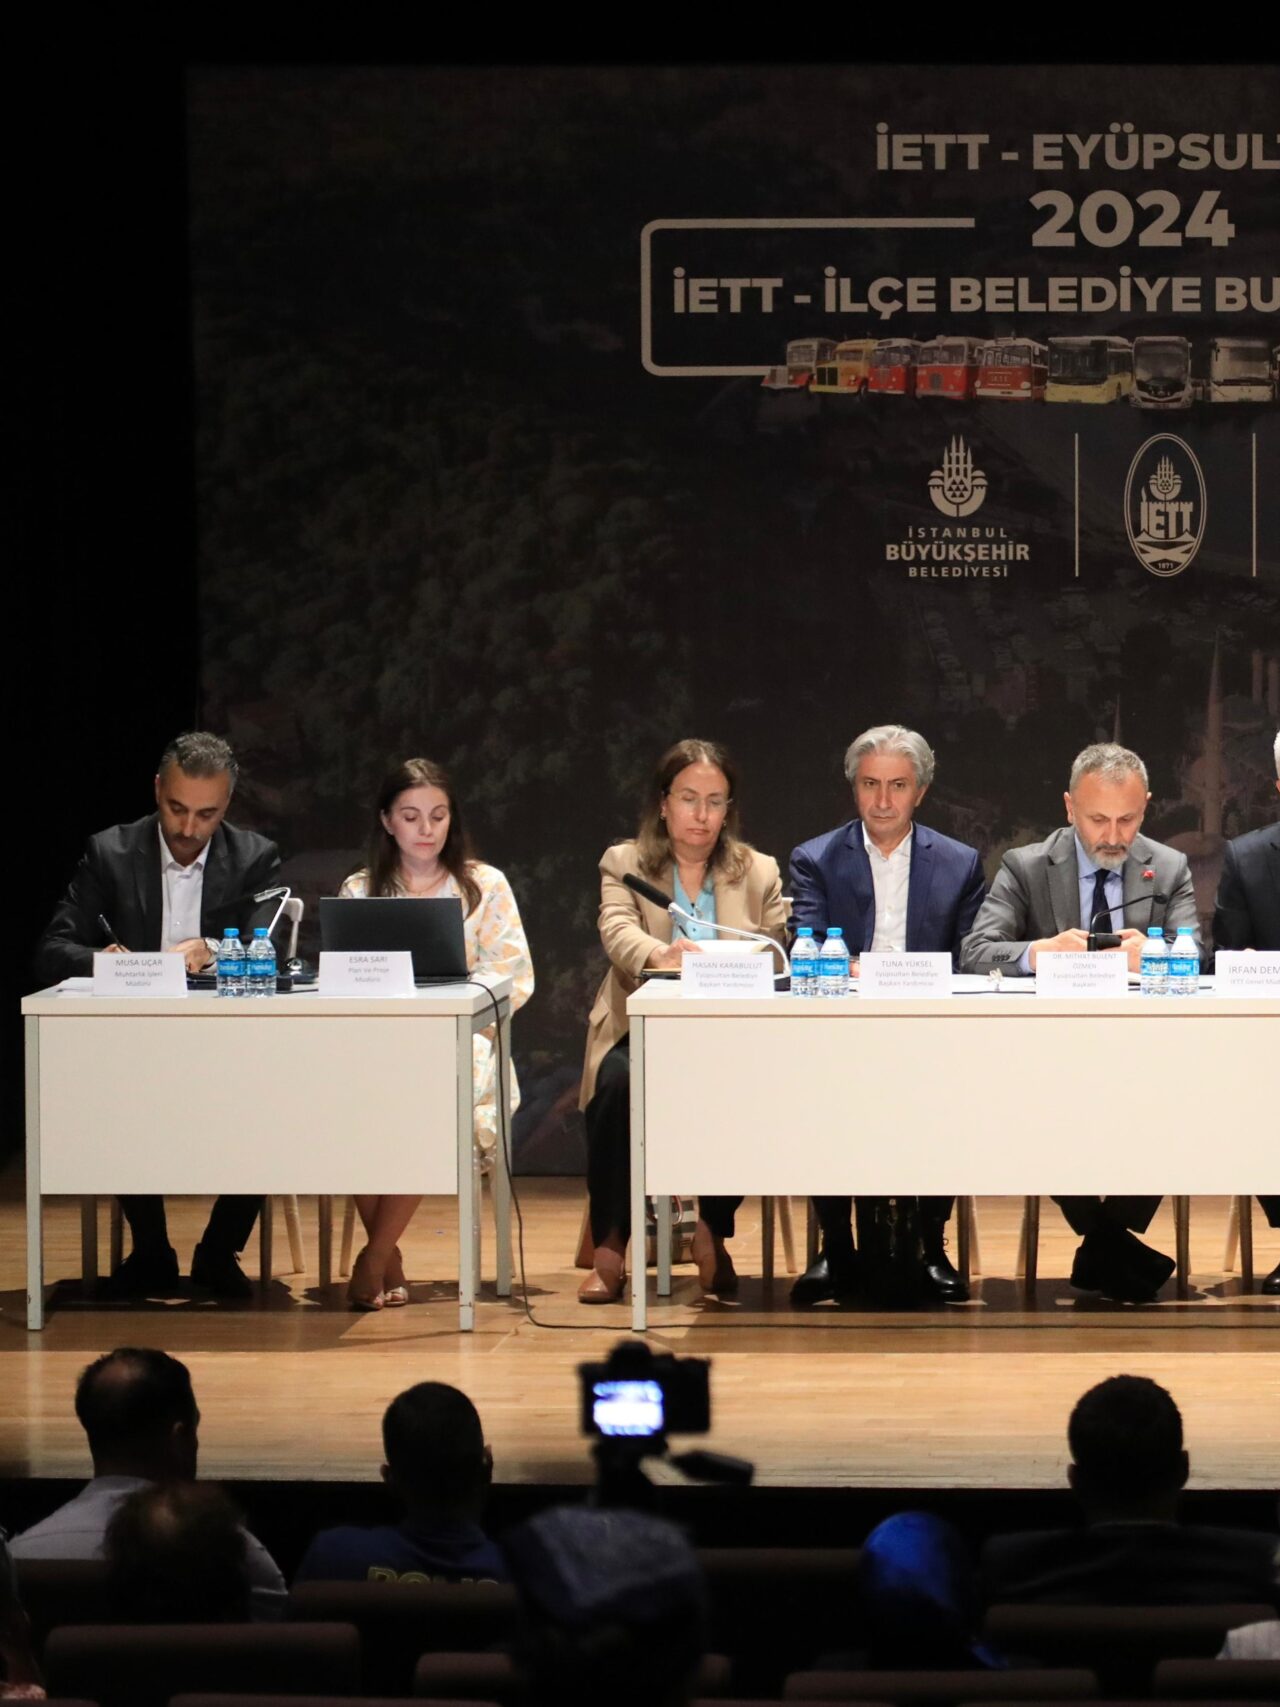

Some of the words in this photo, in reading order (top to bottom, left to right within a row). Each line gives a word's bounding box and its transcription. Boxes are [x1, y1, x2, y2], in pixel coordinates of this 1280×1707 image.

[877, 122, 989, 170] İETT
[1029, 189, 1236, 248] 2024
[674, 266, 783, 313] İETT
[824, 266, 937, 320] İLÇE
[950, 265, 1202, 313] BELEDİYE
[908, 526, 1008, 538] İSTANBUL
[885, 540, 1030, 563] BÜYÜKŞEHİR
[908, 564, 1008, 578] BELEDİYESİ
[115, 959, 139, 967] MUSA
[141, 959, 163, 967] UÇAR
[692, 961, 718, 969] HASAN
[881, 960, 903, 968] TUNA
[904, 960, 933, 968] YÜKSEL
[1229, 965, 1257, 974] İRFAN
